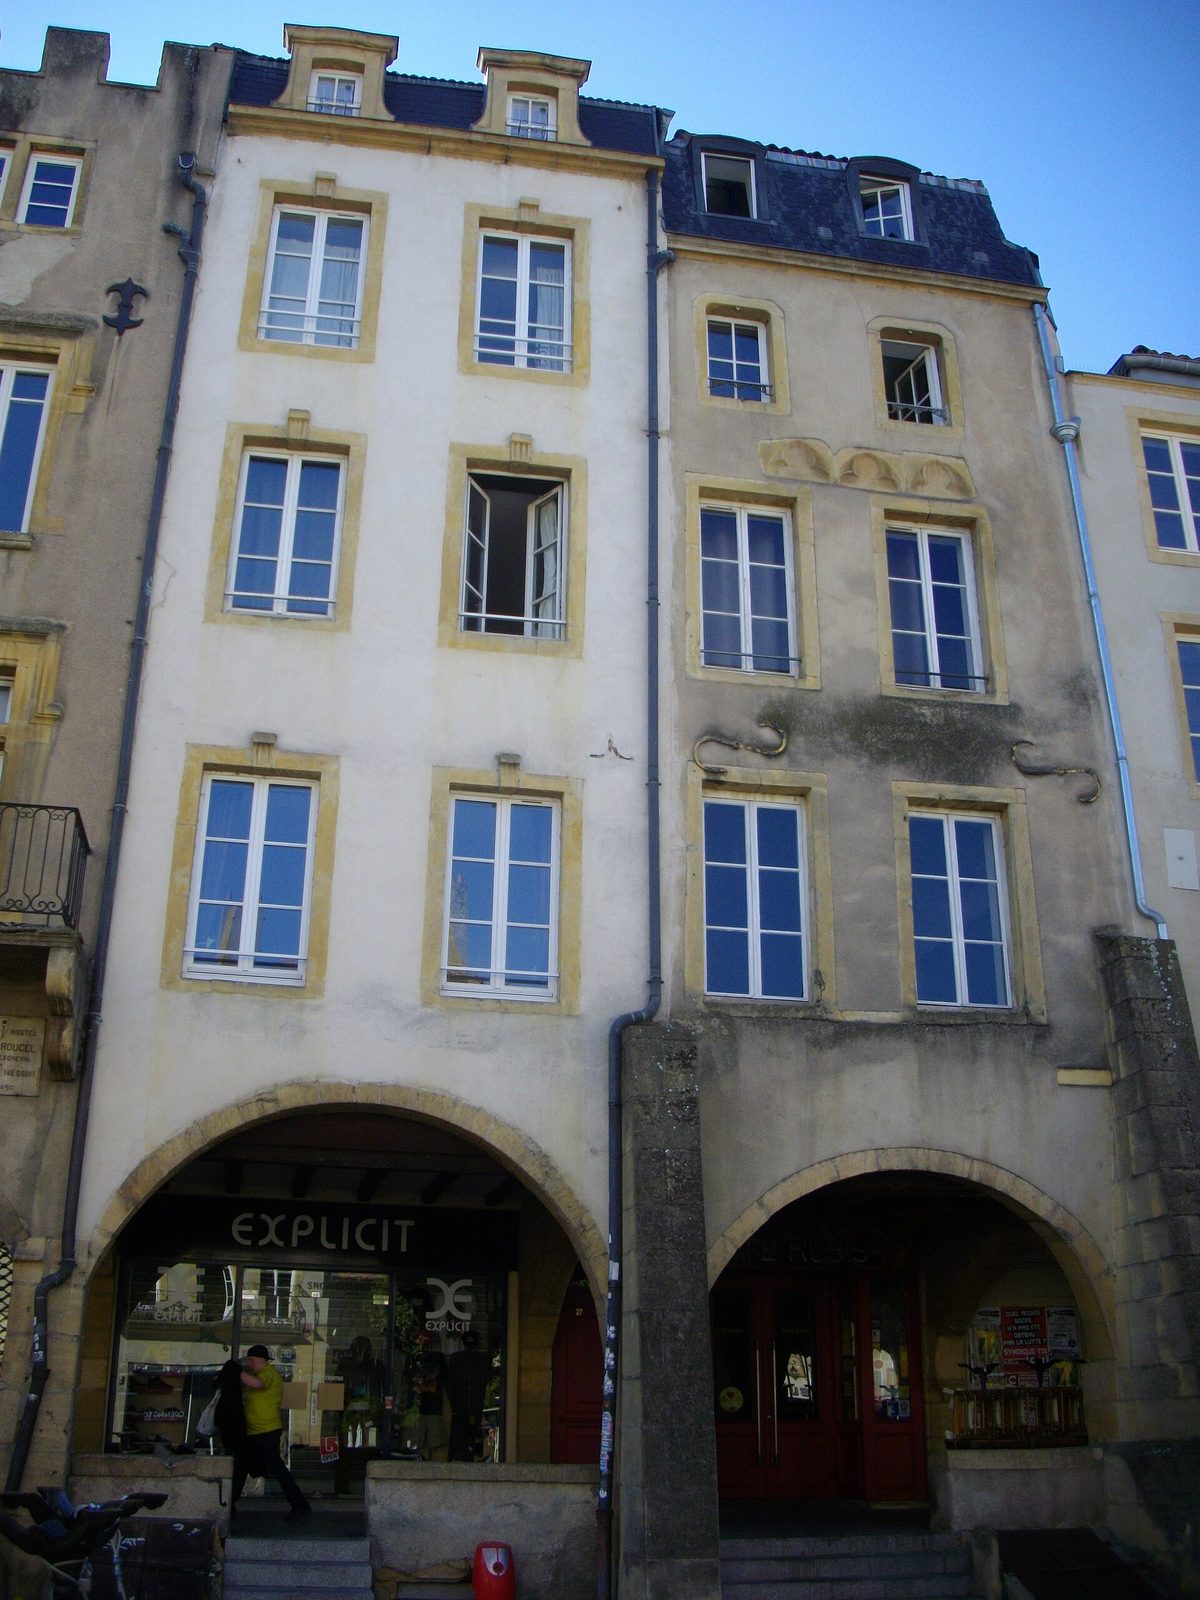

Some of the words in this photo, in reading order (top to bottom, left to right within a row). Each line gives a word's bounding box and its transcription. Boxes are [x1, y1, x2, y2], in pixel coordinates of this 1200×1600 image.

[0, 1042, 35, 1053] ROUCEL
[231, 1213, 415, 1252] EXPLICIT
[425, 1321, 472, 1333] EXPLICIT
